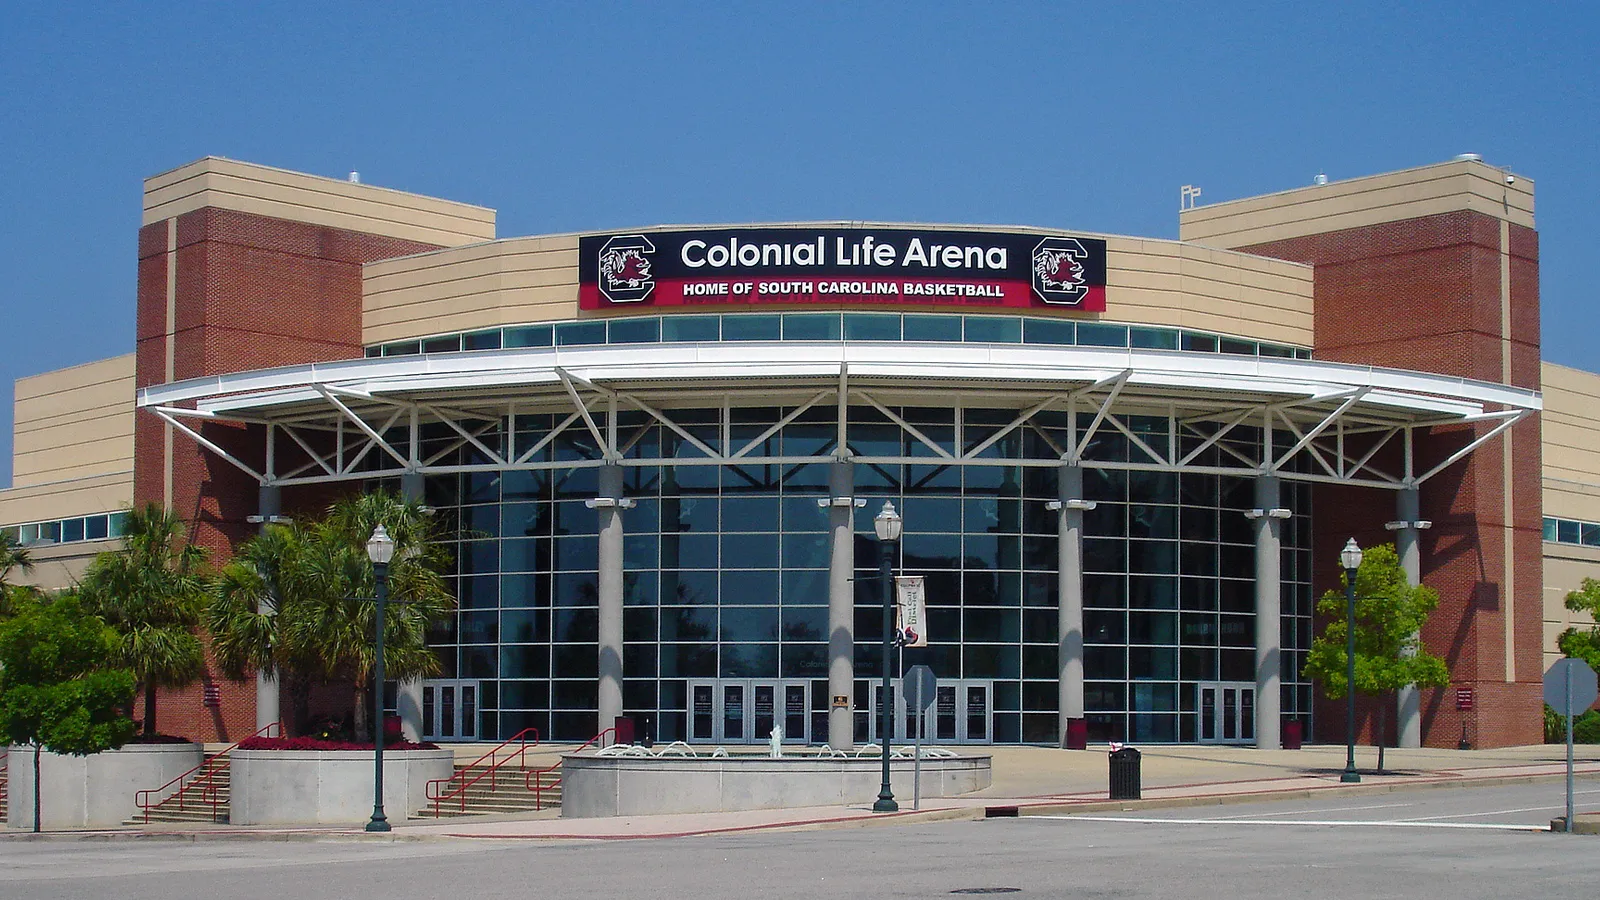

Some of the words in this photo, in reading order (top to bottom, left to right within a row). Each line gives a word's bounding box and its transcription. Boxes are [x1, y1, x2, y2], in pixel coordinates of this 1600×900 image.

[681, 236, 825, 268] Colonial
[836, 235, 896, 267] Life
[902, 237, 1007, 269] Arena
[683, 282, 728, 296] HOME
[732, 282, 752, 295] OF
[758, 281, 813, 295] SOUTH
[817, 281, 898, 296] CAROLINA
[903, 282, 1005, 297] BASKETBALL
